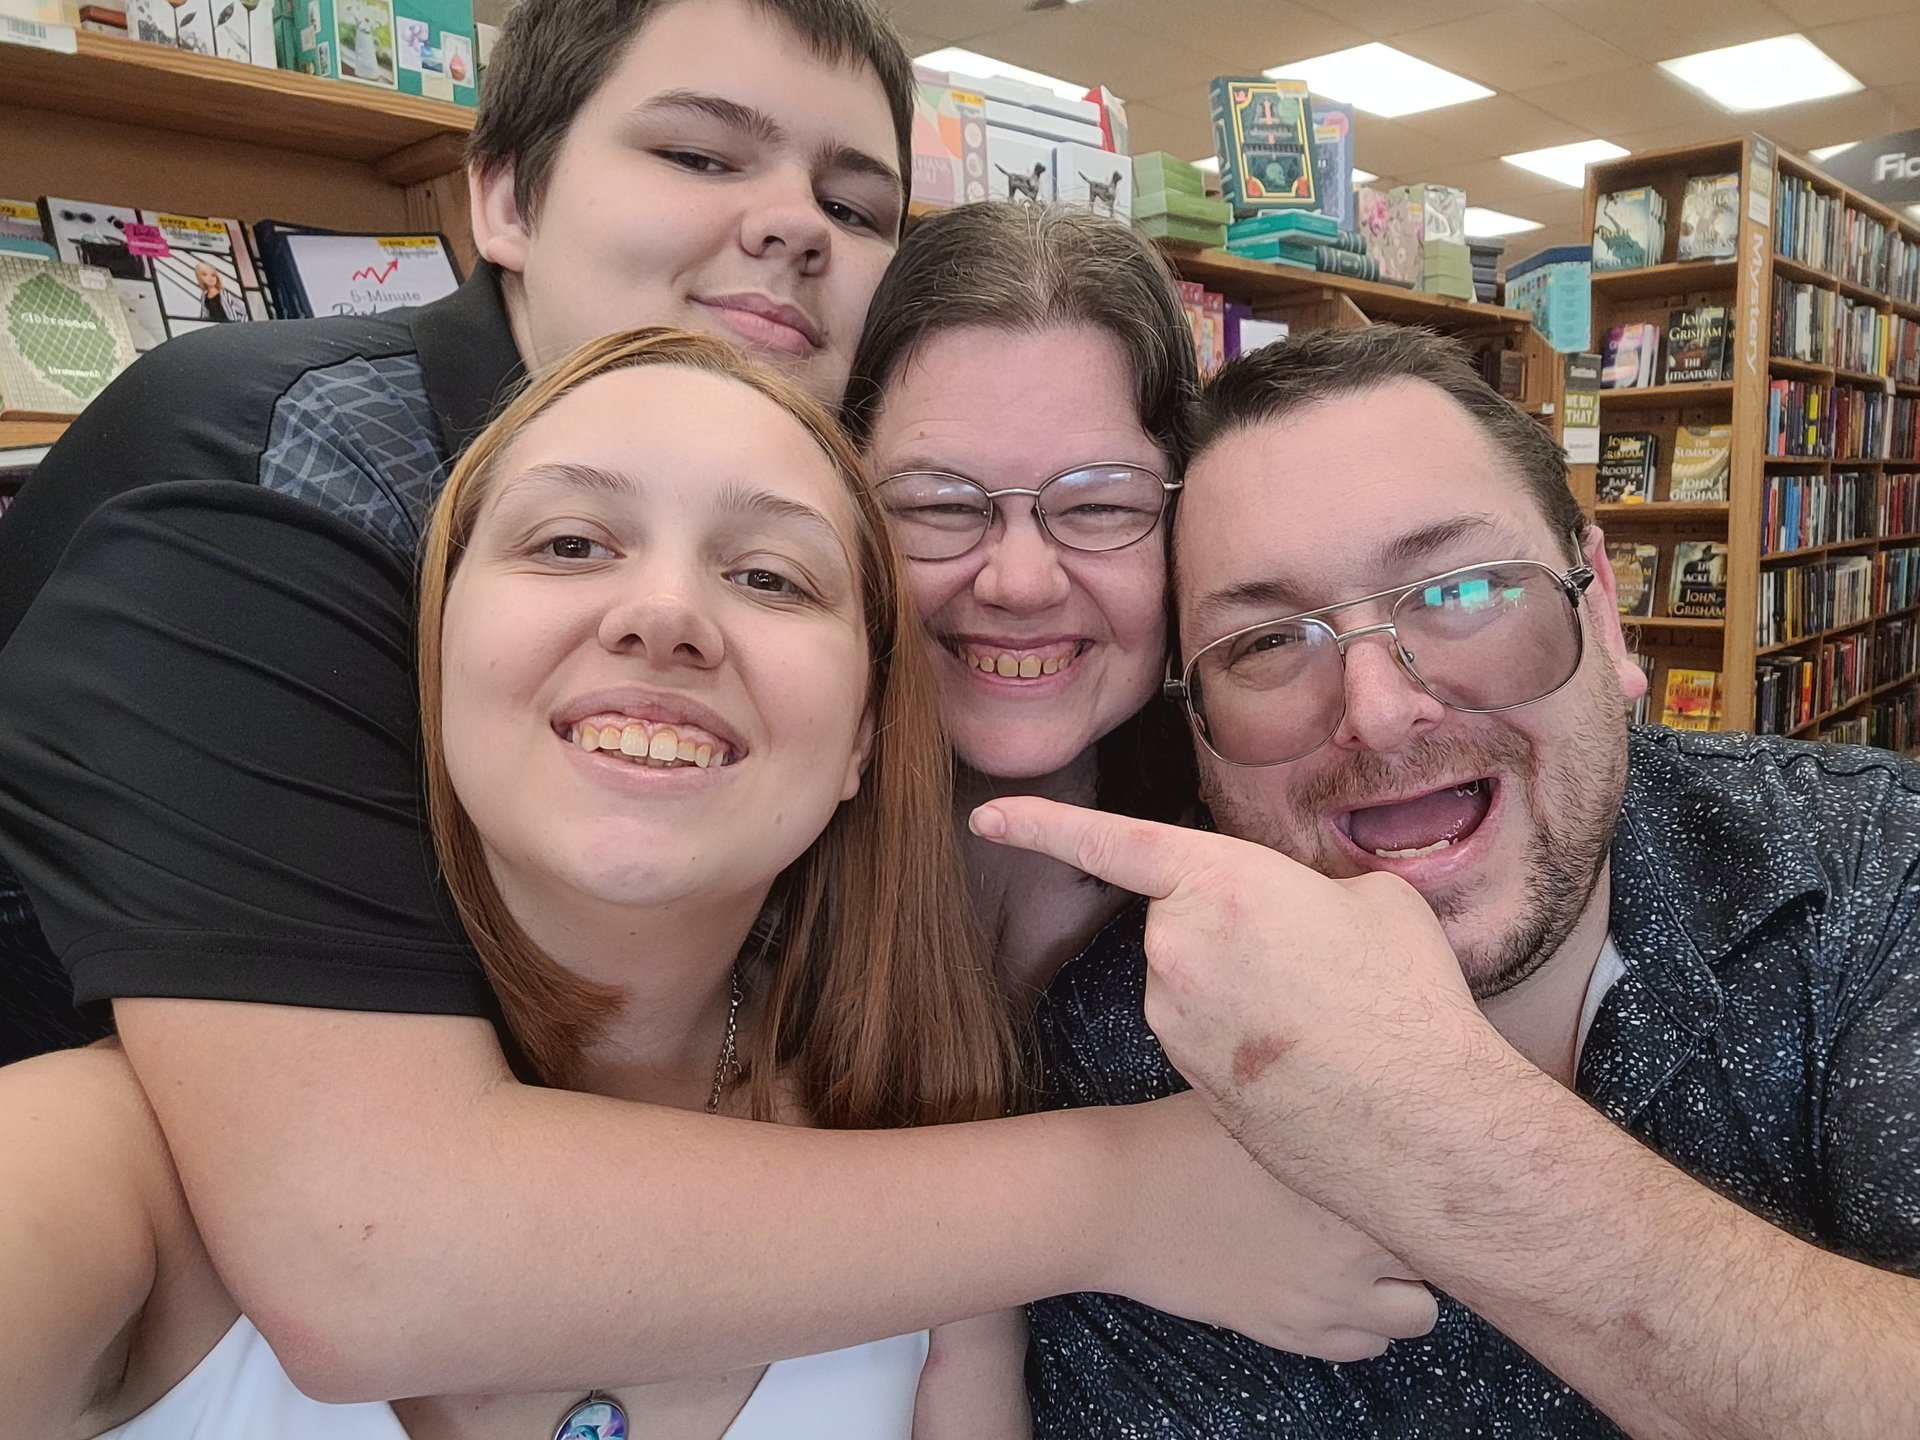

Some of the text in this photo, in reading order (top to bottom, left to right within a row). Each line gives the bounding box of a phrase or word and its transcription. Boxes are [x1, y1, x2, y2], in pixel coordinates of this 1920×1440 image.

[350, 288, 422, 303] 5-Minute
[1746, 233, 1764, 375] Mystery
[1669, 327, 1722, 341] GRISHAM
[1566, 408, 1593, 425] THAT
[1682, 478, 1713, 490] JOHN
[1670, 490, 1721, 501] GRISHAM
[1686, 589, 1716, 603] JOHN
[1674, 602, 1727, 617] GRISHAM
